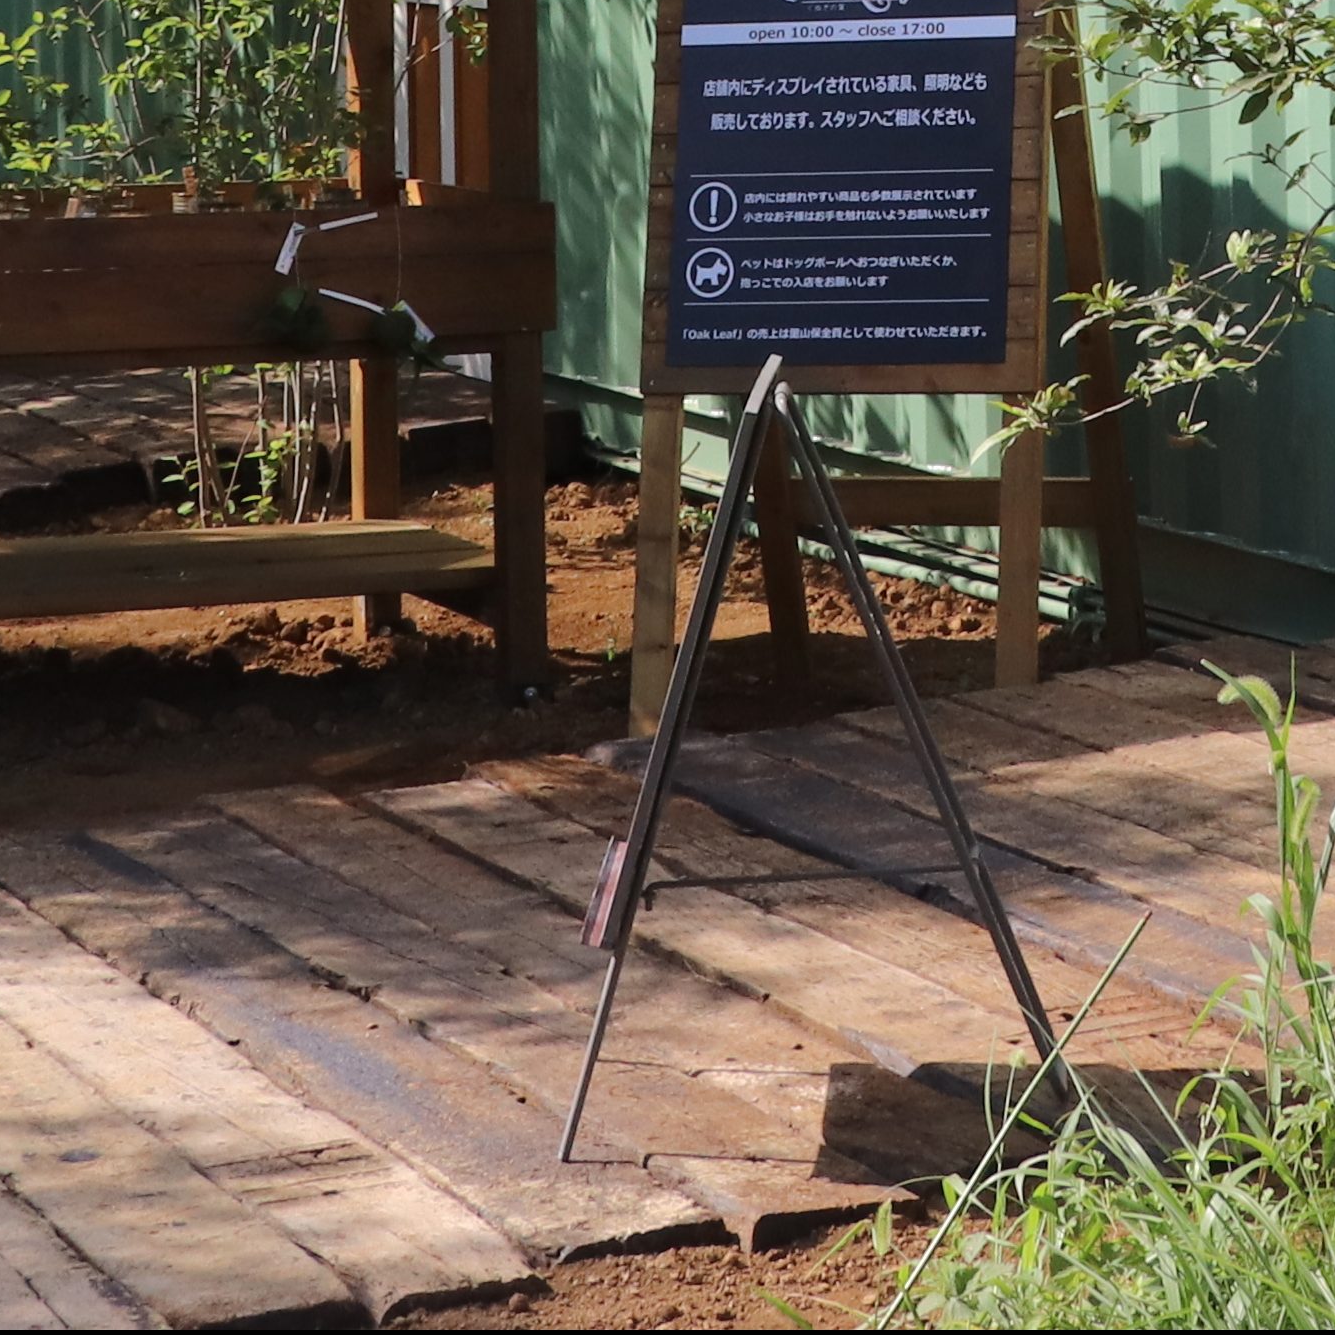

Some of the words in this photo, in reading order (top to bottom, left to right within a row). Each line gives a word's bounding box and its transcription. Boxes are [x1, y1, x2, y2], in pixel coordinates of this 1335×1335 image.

[749, 26, 786, 40] open
[791, 24, 834, 39] 10:00
[858, 23, 896, 37] close
[902, 21, 946, 36] 17:00
[702, 73, 988, 98] 店舗内にディスプレイされている家具、照明なども
[710, 108, 978, 131] 販売しております。スタッフへご相談ください。
